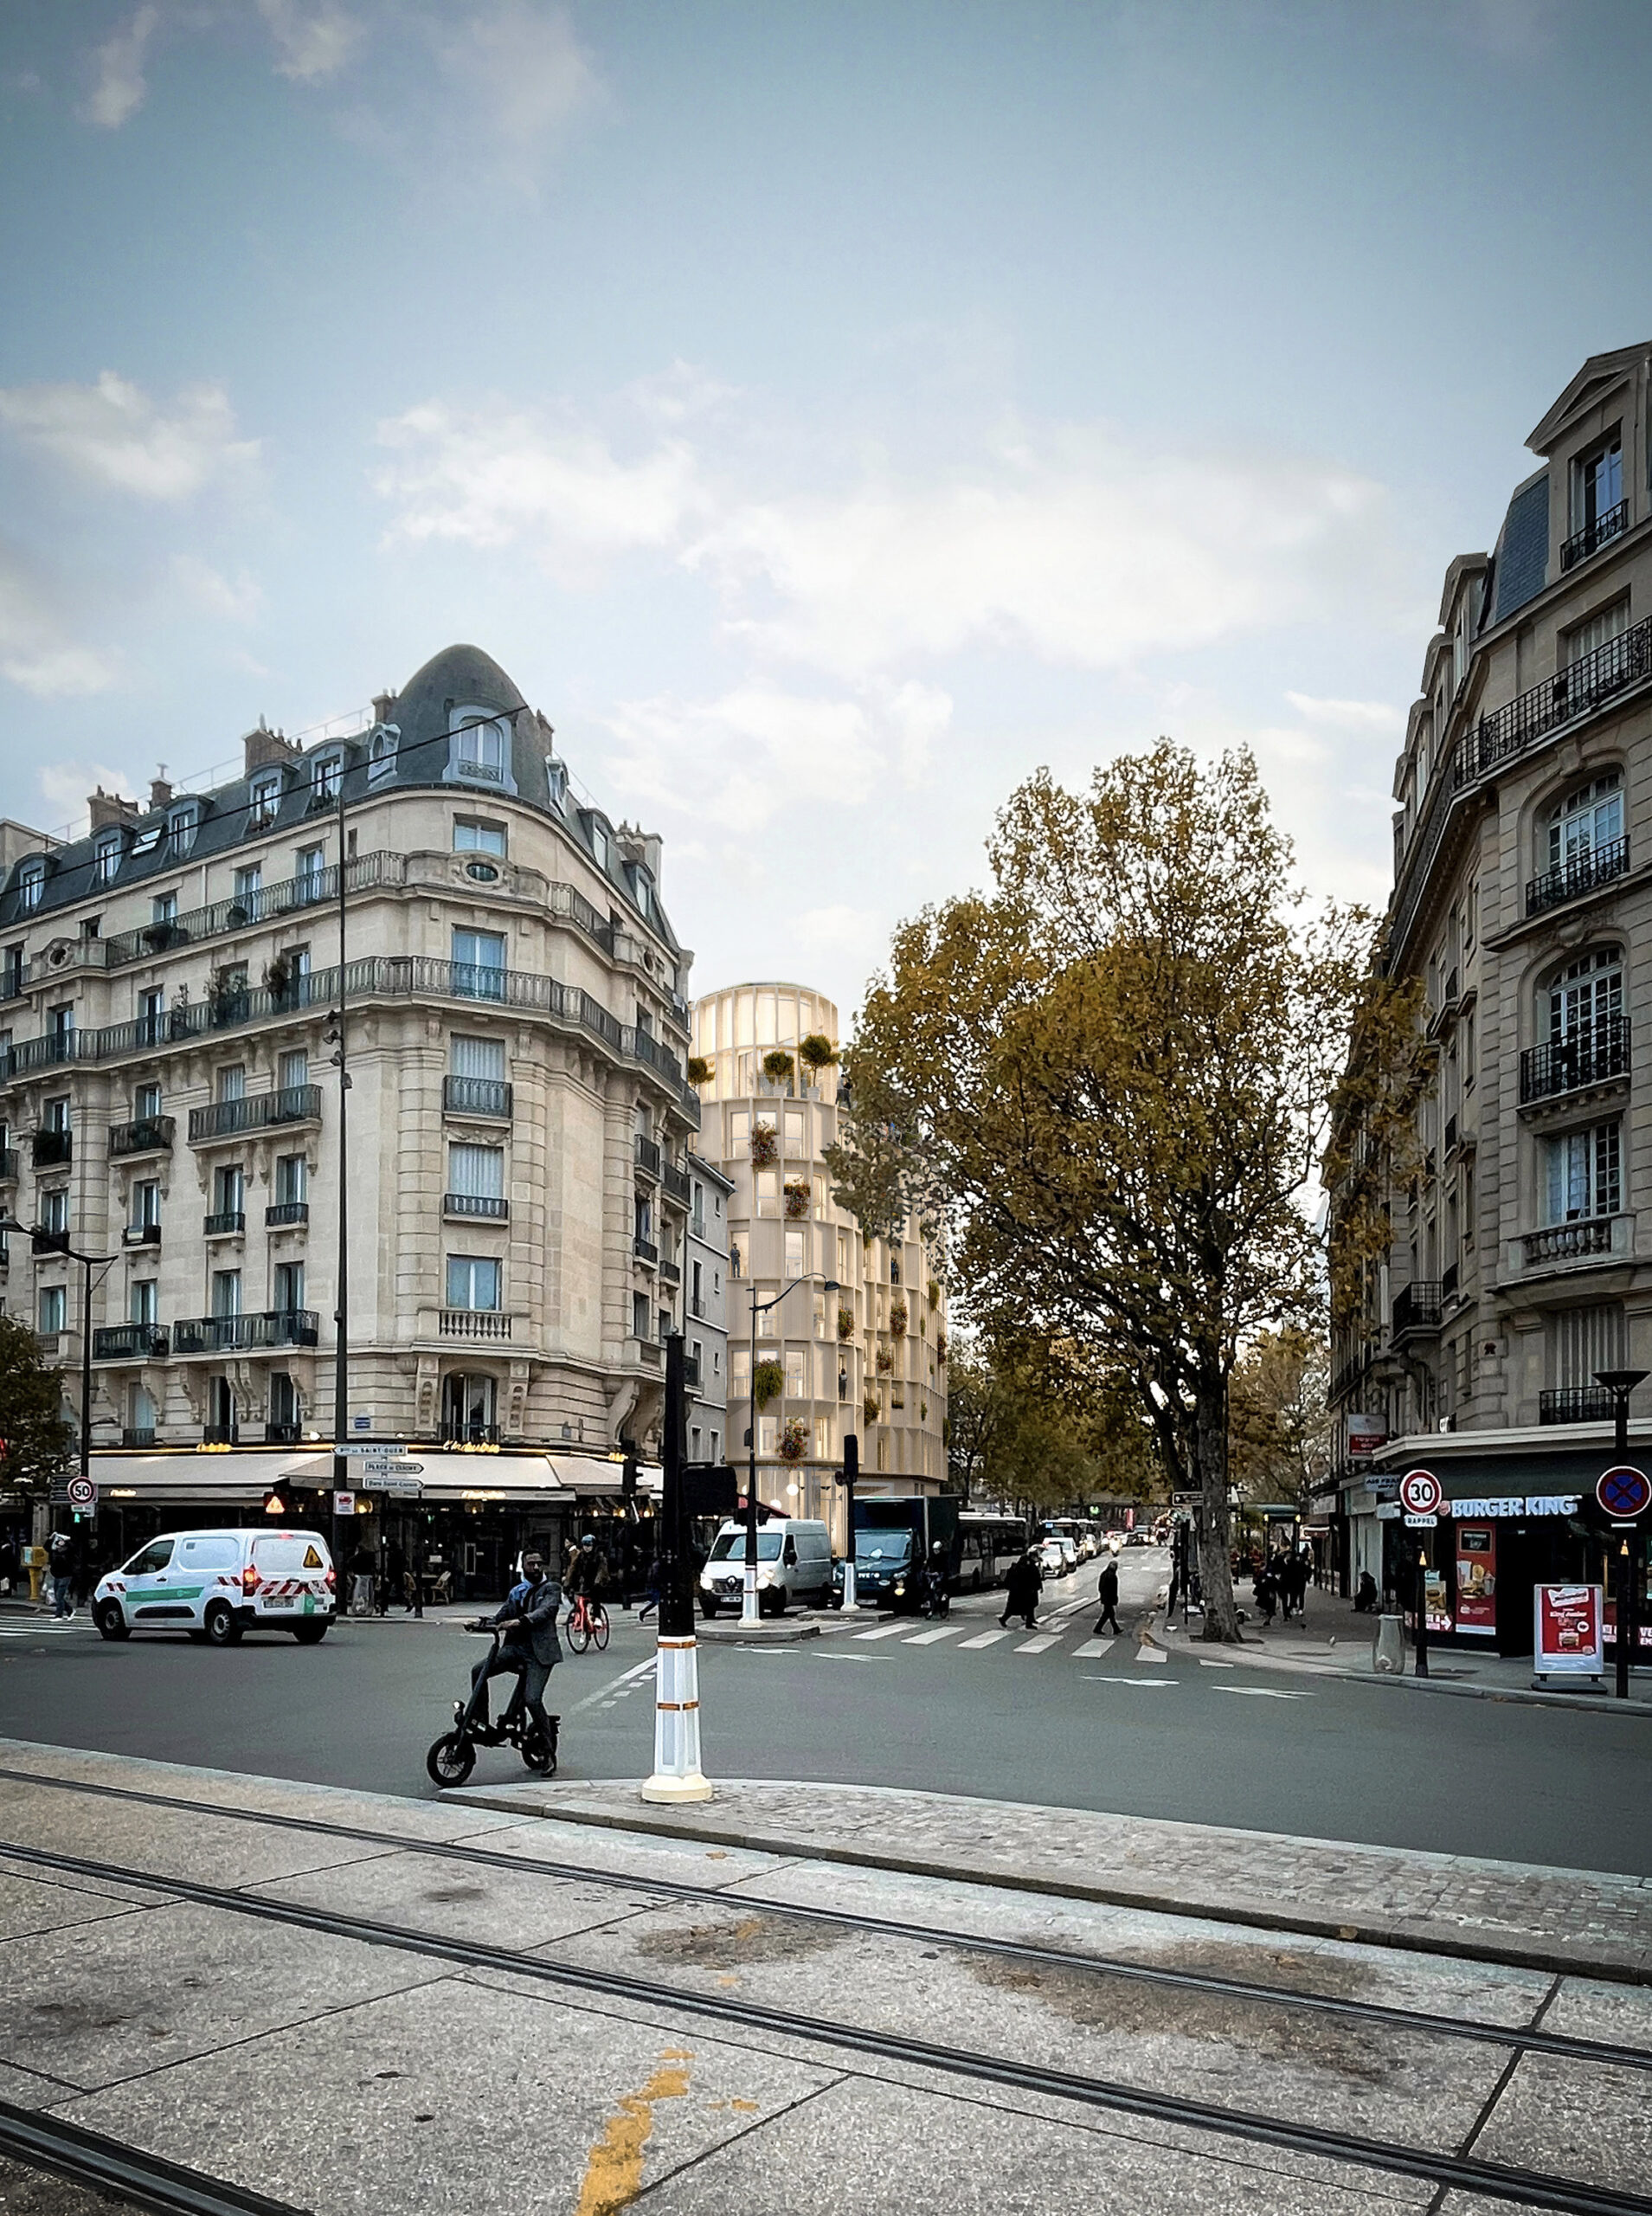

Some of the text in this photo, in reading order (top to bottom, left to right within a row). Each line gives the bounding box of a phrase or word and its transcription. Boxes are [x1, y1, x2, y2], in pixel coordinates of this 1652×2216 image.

[75, 1485, 90, 1497] 50
[1411, 1484, 1433, 1502] 30
[1451, 1498, 1524, 1517] BURGER
[1525, 1495, 1578, 1516] KING
[1407, 1517, 1435, 1525] RAPPEL
